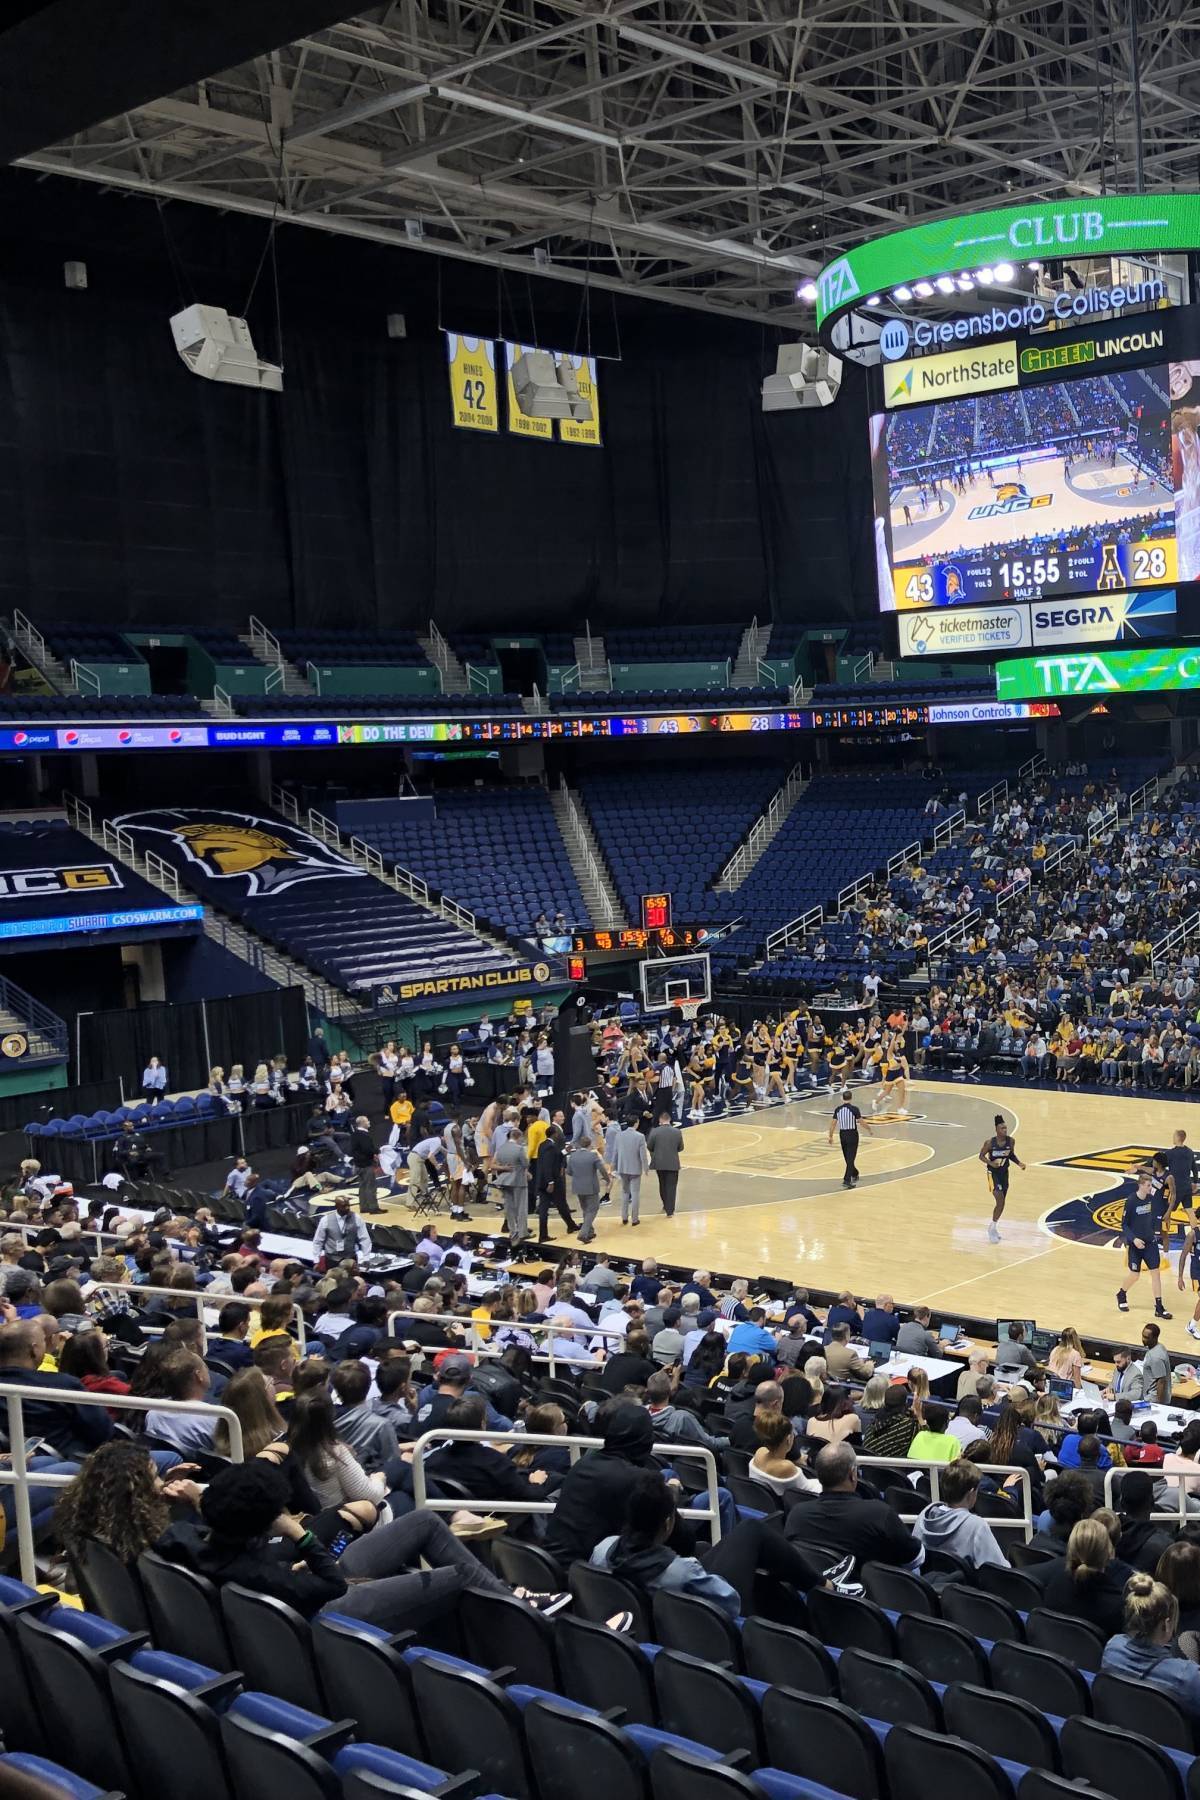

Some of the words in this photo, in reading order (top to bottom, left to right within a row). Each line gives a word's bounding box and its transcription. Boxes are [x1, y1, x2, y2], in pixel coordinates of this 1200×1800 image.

[1009, 211, 1104, 248] CLUB
[818, 258, 860, 315] TFA
[914, 303, 1046, 347] Greensboro
[1054, 279, 1164, 318] Coliseum
[922, 357, 1015, 388] NorthState
[1020, 340, 1095, 373] GREEN
[1096, 330, 1163, 357] LINCOLN
[463, 379, 486, 410] 42
[968, 493, 1054, 520] UNCG
[999, 559, 1059, 588] 15:55
[1134, 549, 1166, 581] 28
[905, 574, 933, 602] 43
[987, 579, 992, 587] 3
[1014, 588, 1034, 597] HALF
[1036, 587, 1042, 596] 2
[939, 615, 1014, 634] ticketmaster
[1035, 607, 1113, 629] SEGRA
[940, 634, 976, 645] VERIFIED
[979, 631, 1011, 642] TICKETS
[1035, 655, 1121, 692] TFA
[867, 712, 873, 721] 2
[931, 705, 970, 721] Johnson
[972, 704, 1012, 719] Controls
[363, 727, 379, 740] DO
[383, 726, 406, 739] THE
[409, 726, 433, 739] DEW
[464, 726, 470, 735] 1
[493, 726, 500, 735] 2
[520, 725, 532, 734] 14
[551, 724, 562, 733] 21
[581, 723, 593, 733] 44
[658, 721, 679, 733] 43
[751, 717, 769, 731] 28
[216, 731, 237, 740] BUD
[237, 731, 266, 740] LIGHT
[646, 897, 667, 907] 15:55
[69, 916, 107, 929] SWARM
[112, 908, 197, 925] GSOSWARM.COM
[647, 908, 665, 927] 30
[400, 975, 484, 999] SPARTAN
[486, 968, 532, 986] CLUB
